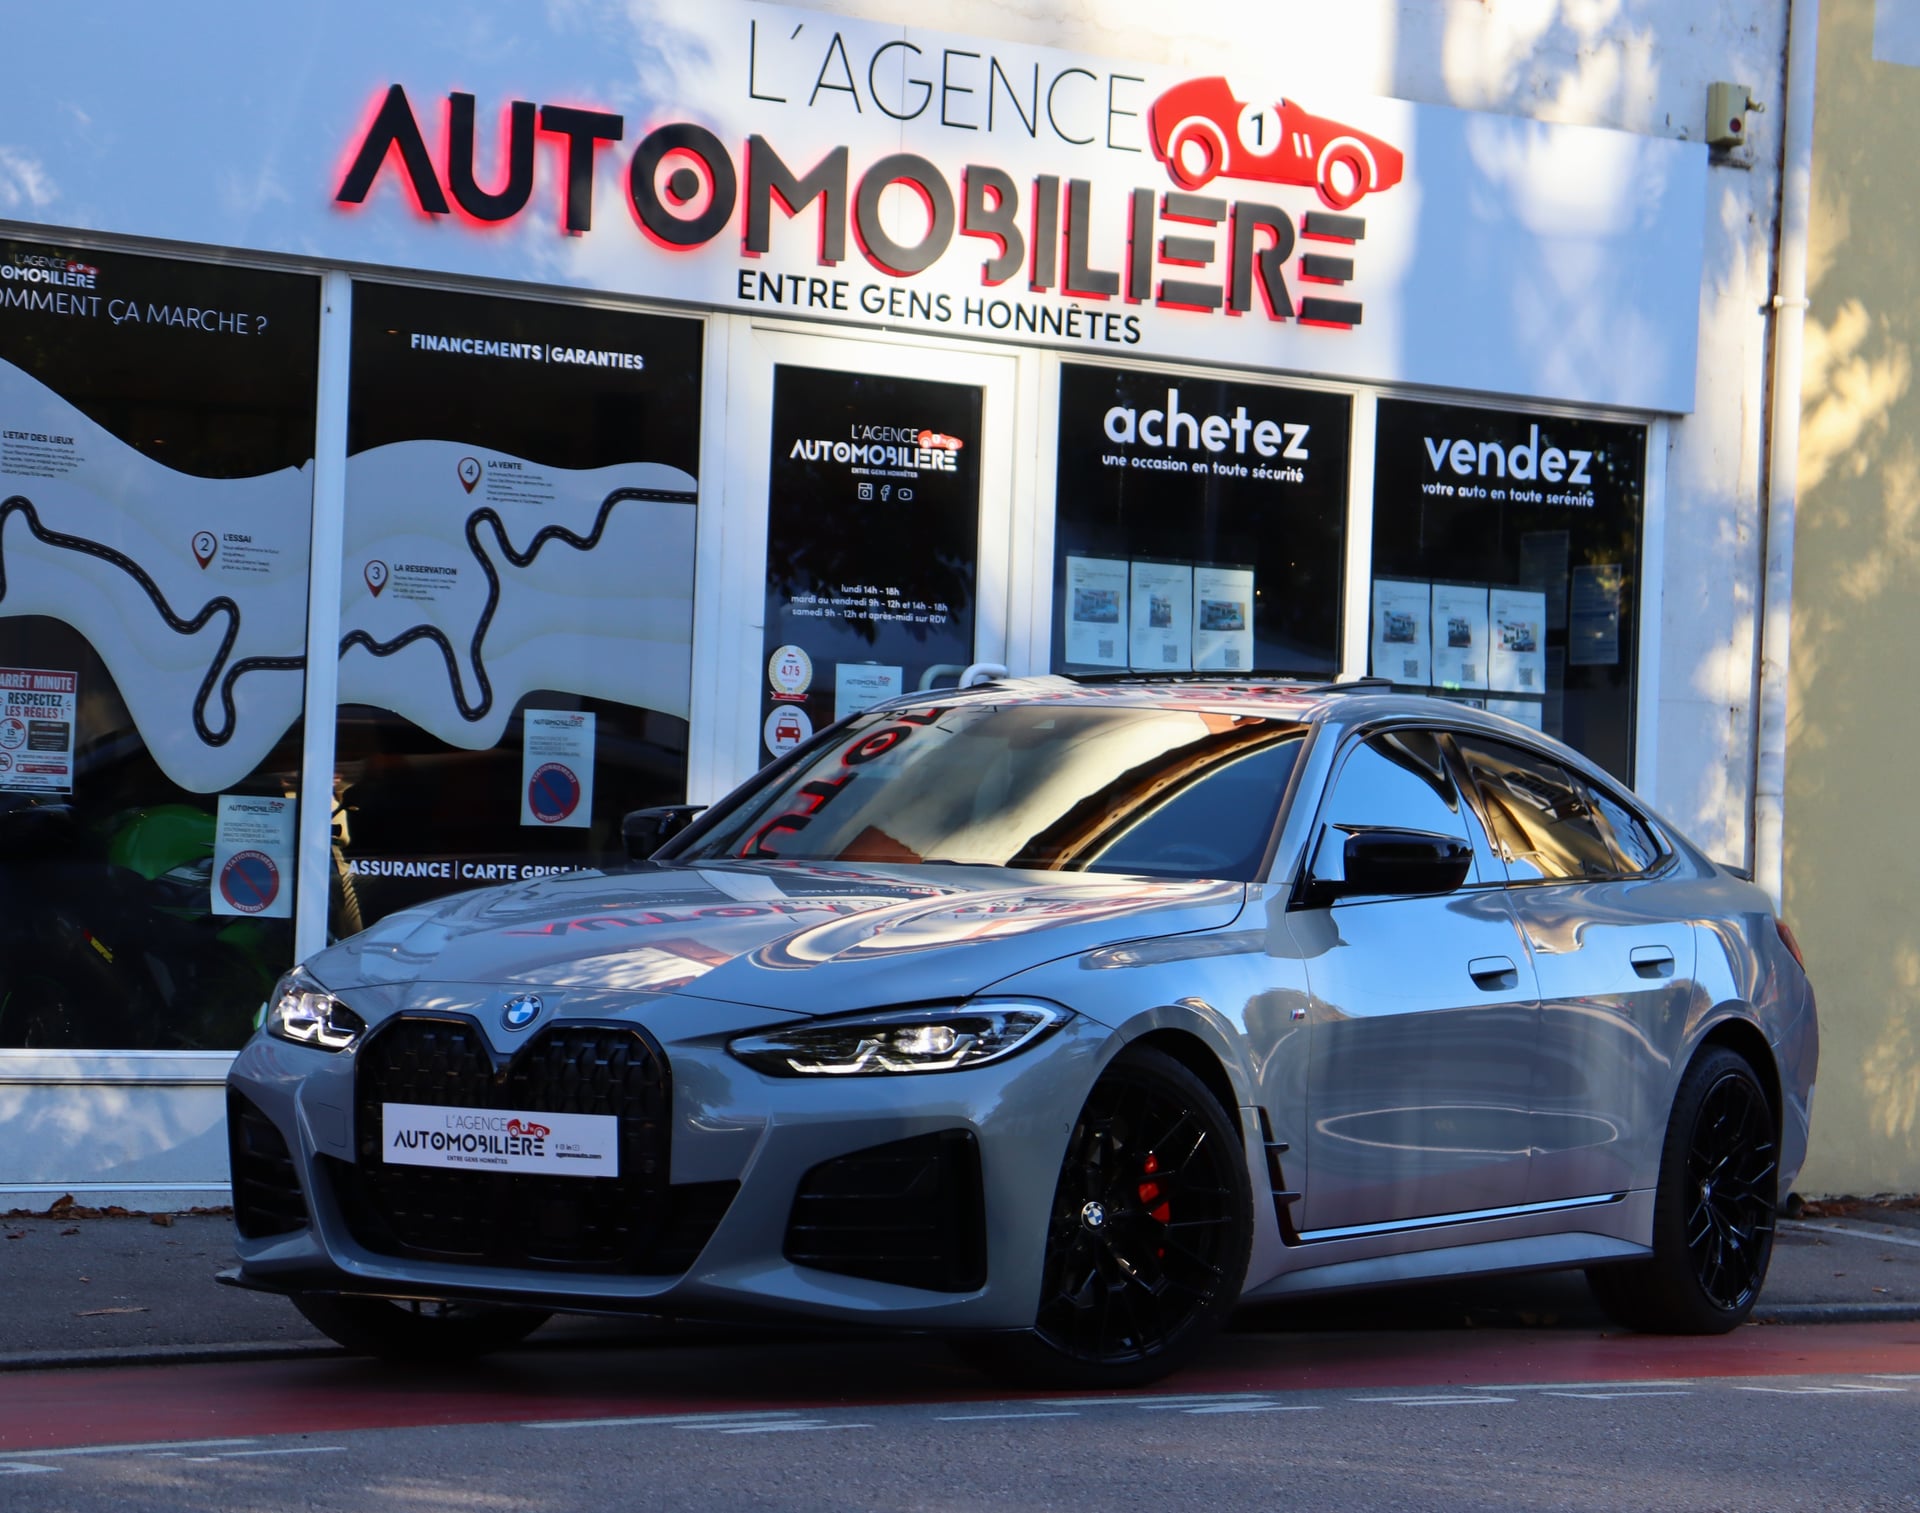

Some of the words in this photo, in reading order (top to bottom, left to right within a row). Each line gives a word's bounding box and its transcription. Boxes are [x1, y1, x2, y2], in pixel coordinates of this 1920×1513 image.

[748, 18, 1147, 154] L'AGENCE
[336, 83, 1367, 329] AUTOMOBILIERE
[738, 269, 850, 310] ENTRE
[860, 284, 953, 322] GENS
[963, 297, 1142, 345] HONNÊTES
[107, 299, 140, 325] ÇA
[146, 303, 249, 335] MARCHE
[255, 315, 268, 336] ?
[410, 333, 542, 361] FINANCEMENTS
[551, 347, 644, 370] GARANTIES
[851, 423, 920, 444] L'AGENCE
[1103, 388, 1310, 461] achetez
[30, 433, 48, 443] DES
[49, 435, 74, 446] LIEUX
[789, 438, 958, 472] AUTOMOBILIERE
[1423, 424, 1593, 485] vendez
[464, 464, 474, 477] 4
[487, 460, 497, 469] LA
[499, 462, 522, 471] VENTE
[1102, 454, 1127, 466] une
[1131, 455, 1188, 472] occasion
[1191, 463, 1208, 474] en
[1212, 461, 1249, 477] toute
[1252, 463, 1304, 483] sécurité
[1421, 482, 1454, 496] votre
[1458, 485, 1487, 499] auto
[1490, 489, 1506, 500] en
[1509, 488, 1543, 503] toute
[200, 537, 209, 552] 2
[372, 566, 381, 580] 3
[394, 563, 404, 572] LA
[404, 564, 457, 576] RESERVATION
[841, 584, 862, 593] lundi
[863, 586, 878, 594] 14h
[886, 587, 900, 596] 18h
[791, 595, 816, 604] mardi
[830, 596, 867, 607] vendredi
[868, 598, 880, 607] 9h
[887, 599, 901, 608] 12h
[902, 601, 911, 609] et
[912, 602, 926, 610] 14h
[934, 603, 948, 612] 18h
[792, 607, 823, 617] samedi
[824, 608, 836, 617] 9h
[843, 610, 857, 618] 12h
[858, 611, 867, 619] et
[915, 615, 928, 623] sur
[929, 614, 947, 624] RDV
[33, 675, 73, 691] MINUTE
[8, 692, 63, 707] RESPECTEZ
[5, 705, 21, 717] LES
[7, 728, 16, 736] 15
[349, 859, 451, 878] ASSURANCE
[462, 863, 517, 880] CARTE
[445, 1114, 508, 1132] L'AGENCE
[393, 1130, 545, 1157] AUTOMOBILIERE
